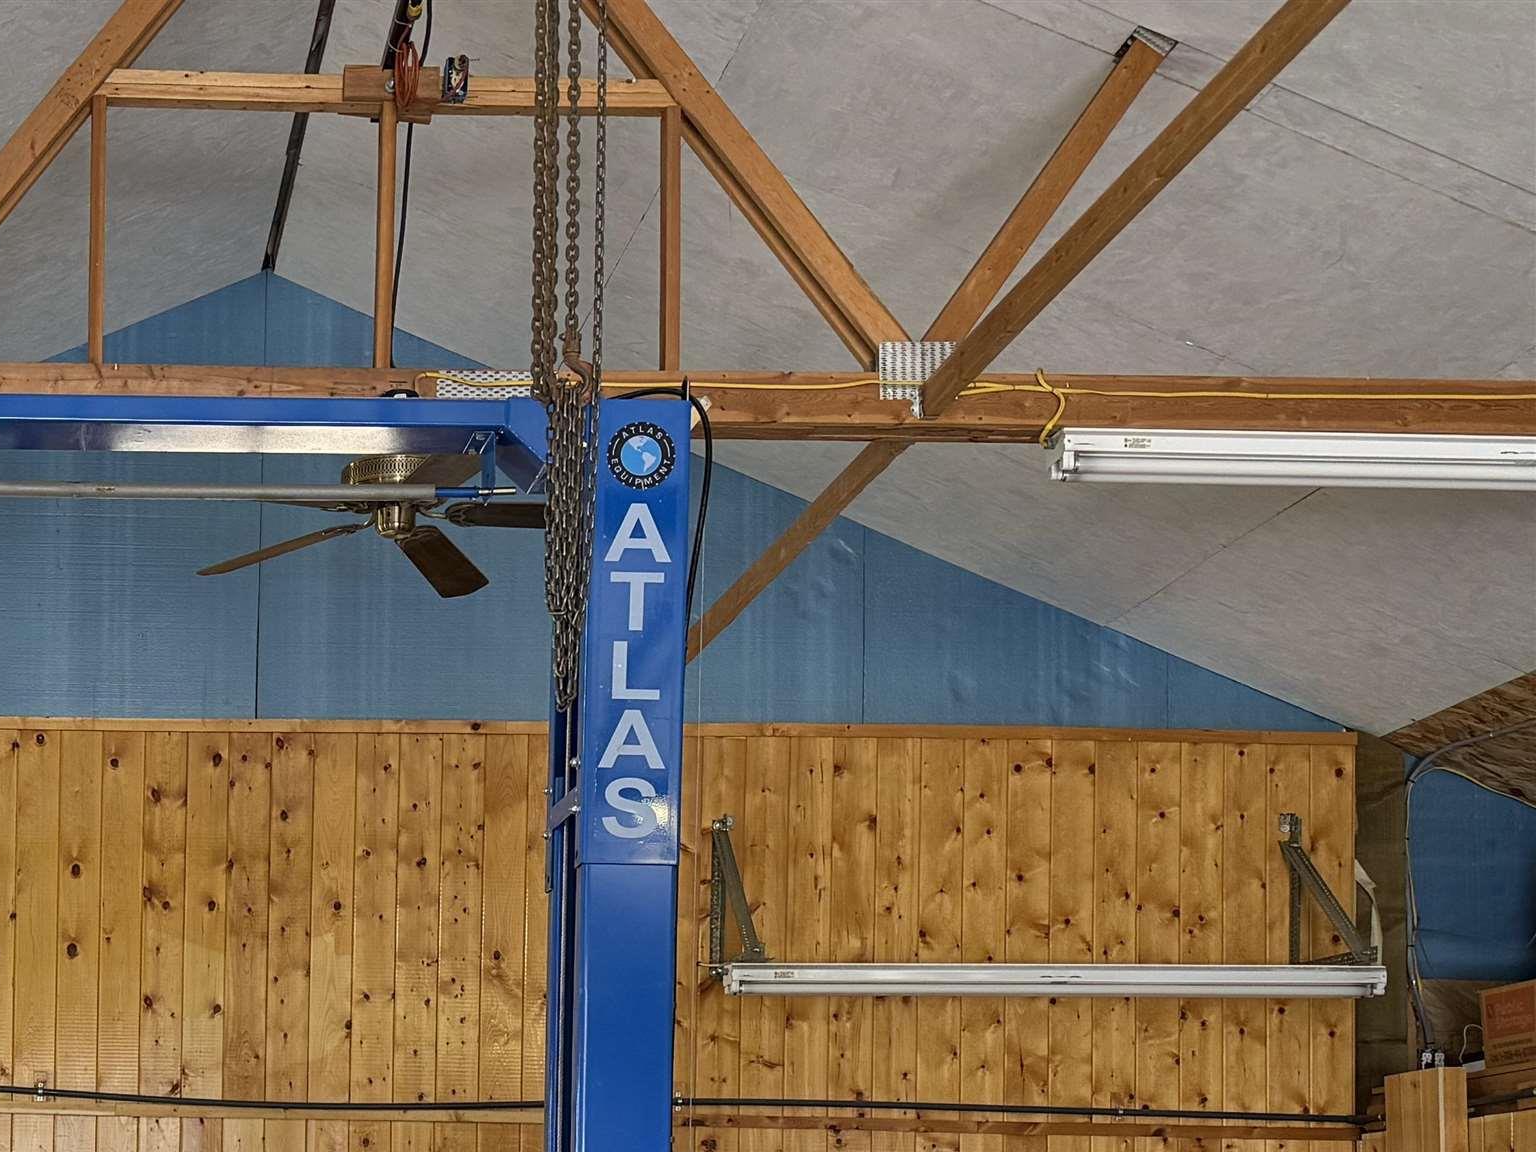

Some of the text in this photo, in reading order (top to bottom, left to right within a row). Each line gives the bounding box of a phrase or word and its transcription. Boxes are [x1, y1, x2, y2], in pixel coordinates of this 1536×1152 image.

[622, 425, 664, 440] ATLAS
[611, 458, 671, 486] EQUIPMENT
[597, 502, 672, 839] ATLAS
